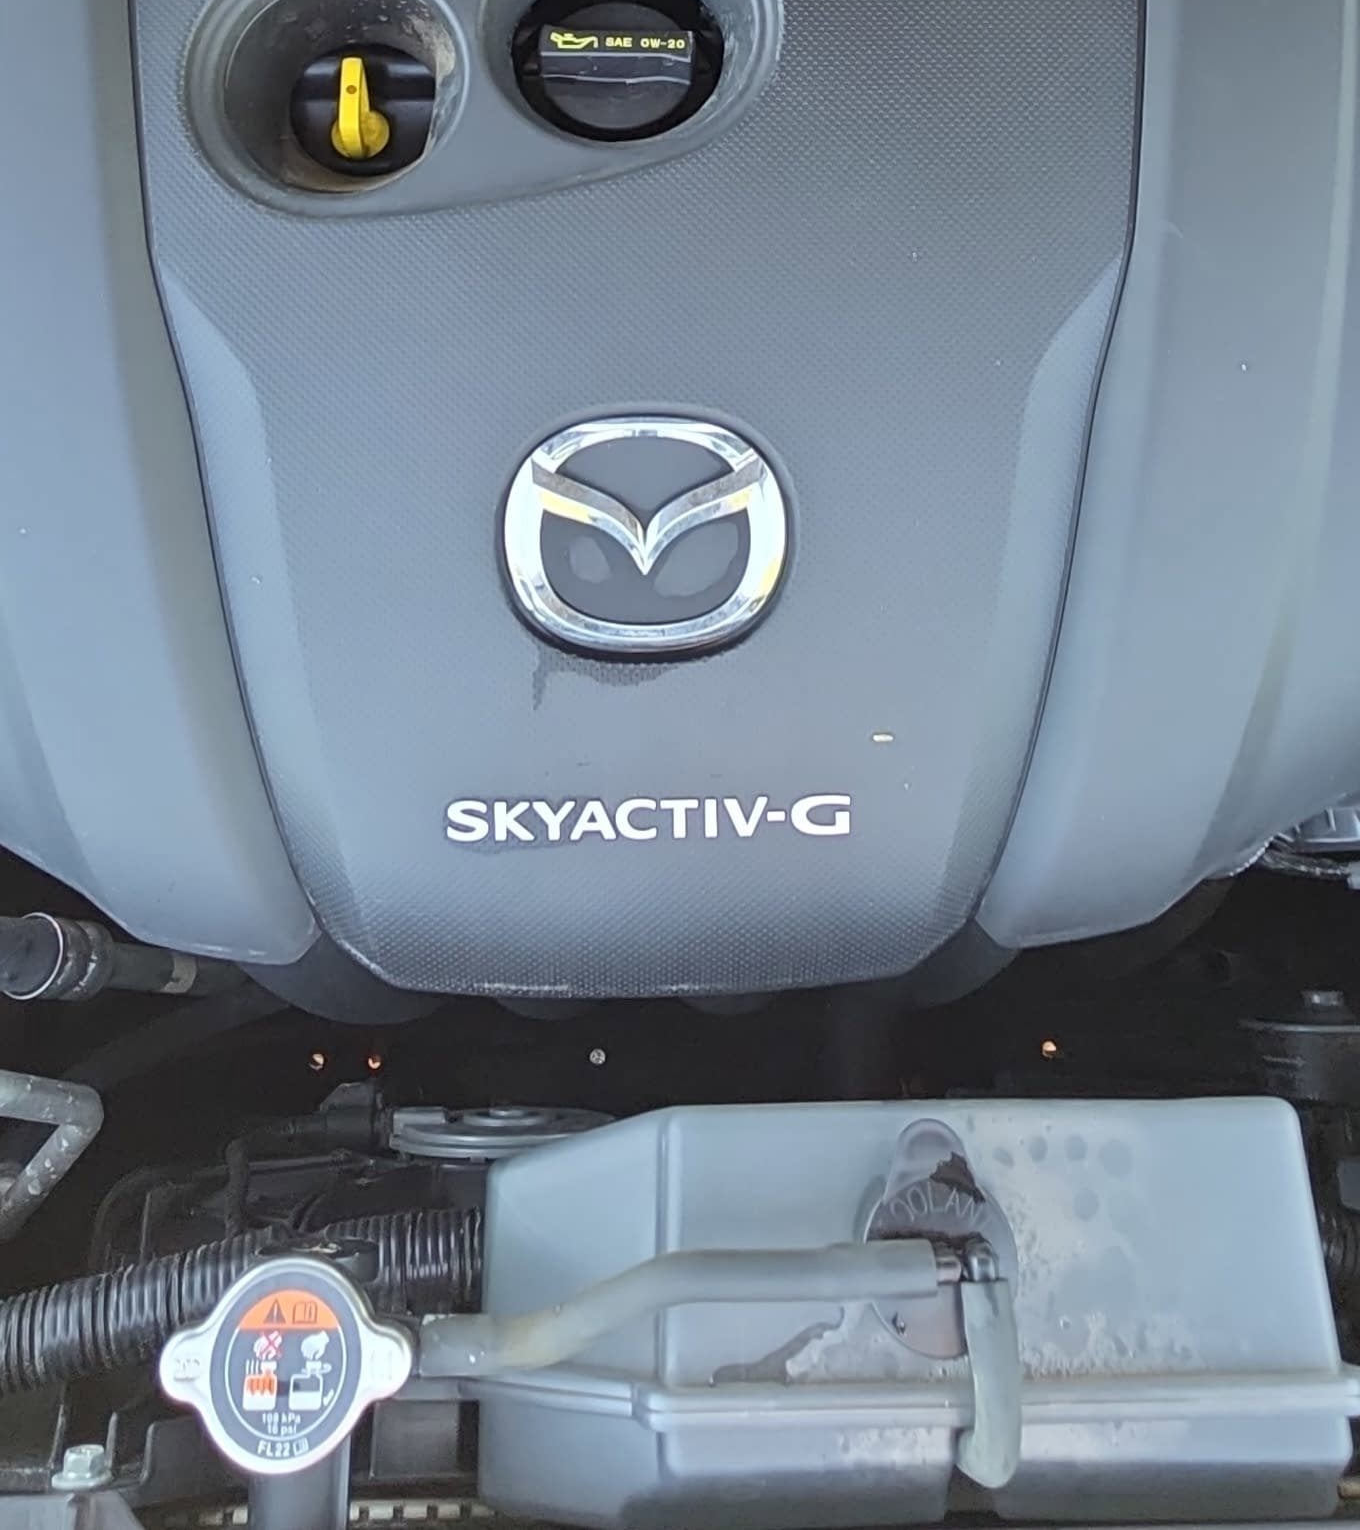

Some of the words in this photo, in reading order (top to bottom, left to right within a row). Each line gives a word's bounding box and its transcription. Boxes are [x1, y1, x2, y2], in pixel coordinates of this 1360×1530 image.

[605, 37, 632, 48] SAE
[640, 38, 686, 49] 0W-20
[446, 794, 851, 842] SKYACTIV-G
[878, 1180, 990, 1230] OOLAN
[257, 1439, 290, 1458] FL22
